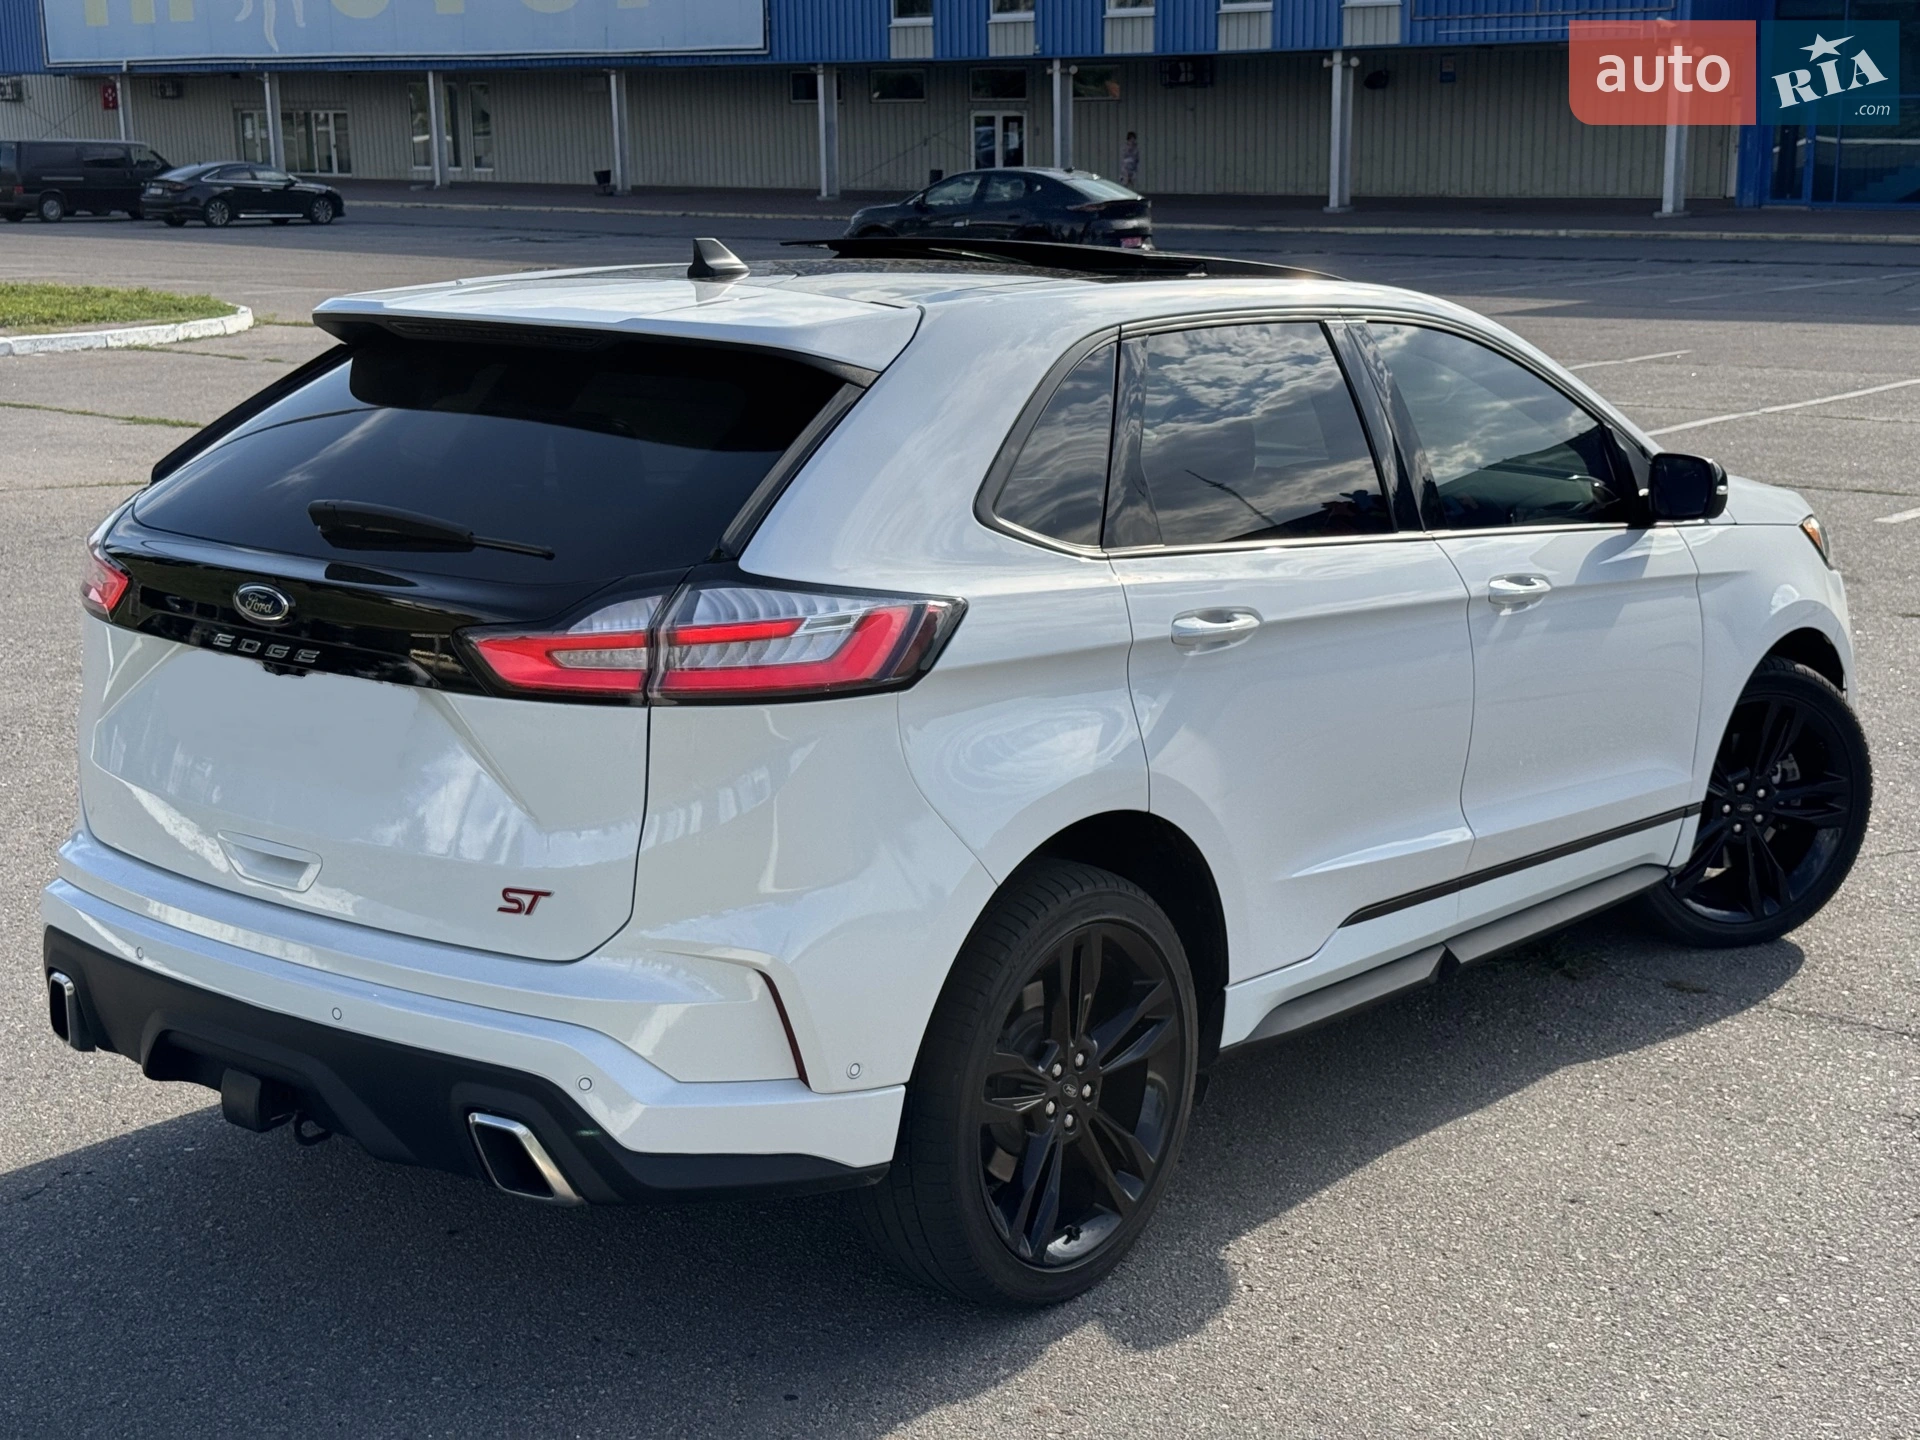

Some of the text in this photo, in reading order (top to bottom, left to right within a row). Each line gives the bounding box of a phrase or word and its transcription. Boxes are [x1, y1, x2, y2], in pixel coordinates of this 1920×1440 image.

[245, 592, 274, 614] Ford
[212, 633, 321, 664] EDGE
[496, 887, 555, 916] ST
